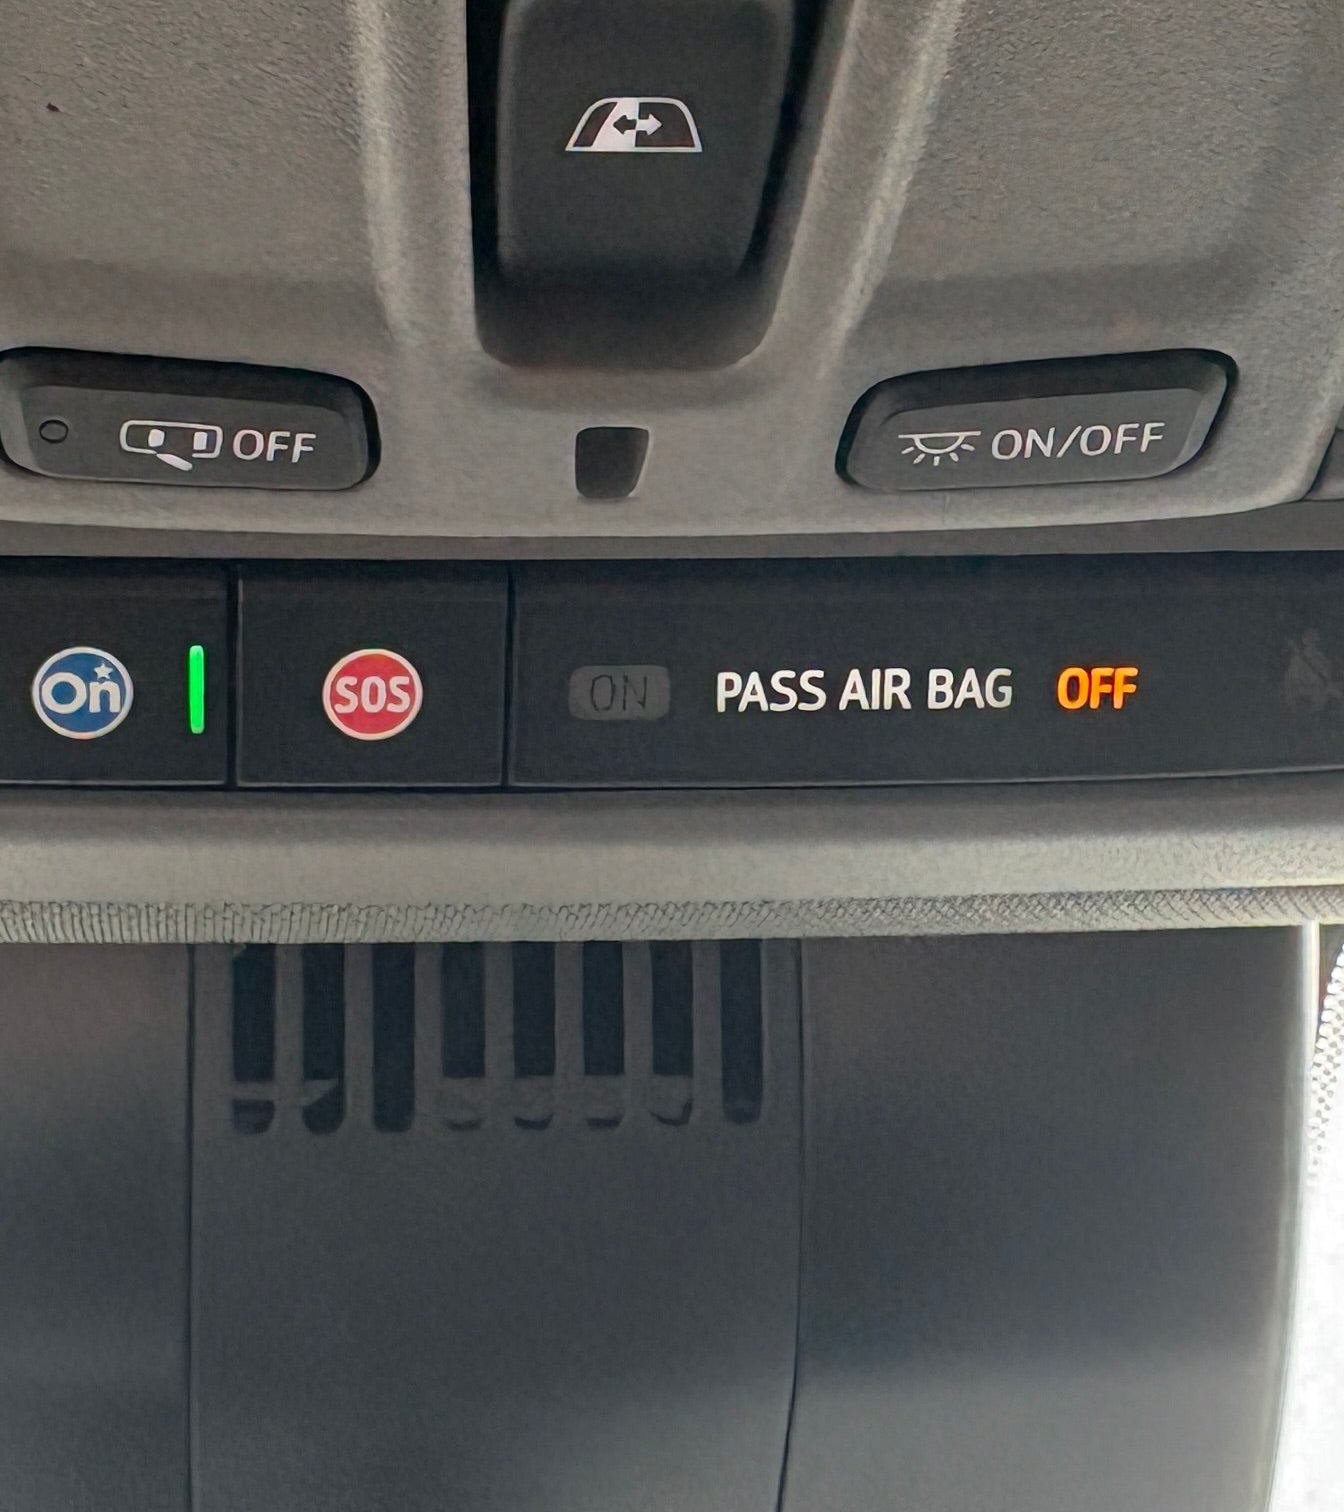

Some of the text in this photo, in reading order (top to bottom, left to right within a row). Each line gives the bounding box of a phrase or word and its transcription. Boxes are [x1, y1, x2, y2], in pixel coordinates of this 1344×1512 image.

[232, 429, 317, 463] OFF
[992, 421, 1165, 461] ON/OFF
[41, 671, 121, 714] On
[333, 675, 411, 714] SOS
[589, 667, 1140, 714] ON PASS AIR BAG OFF
